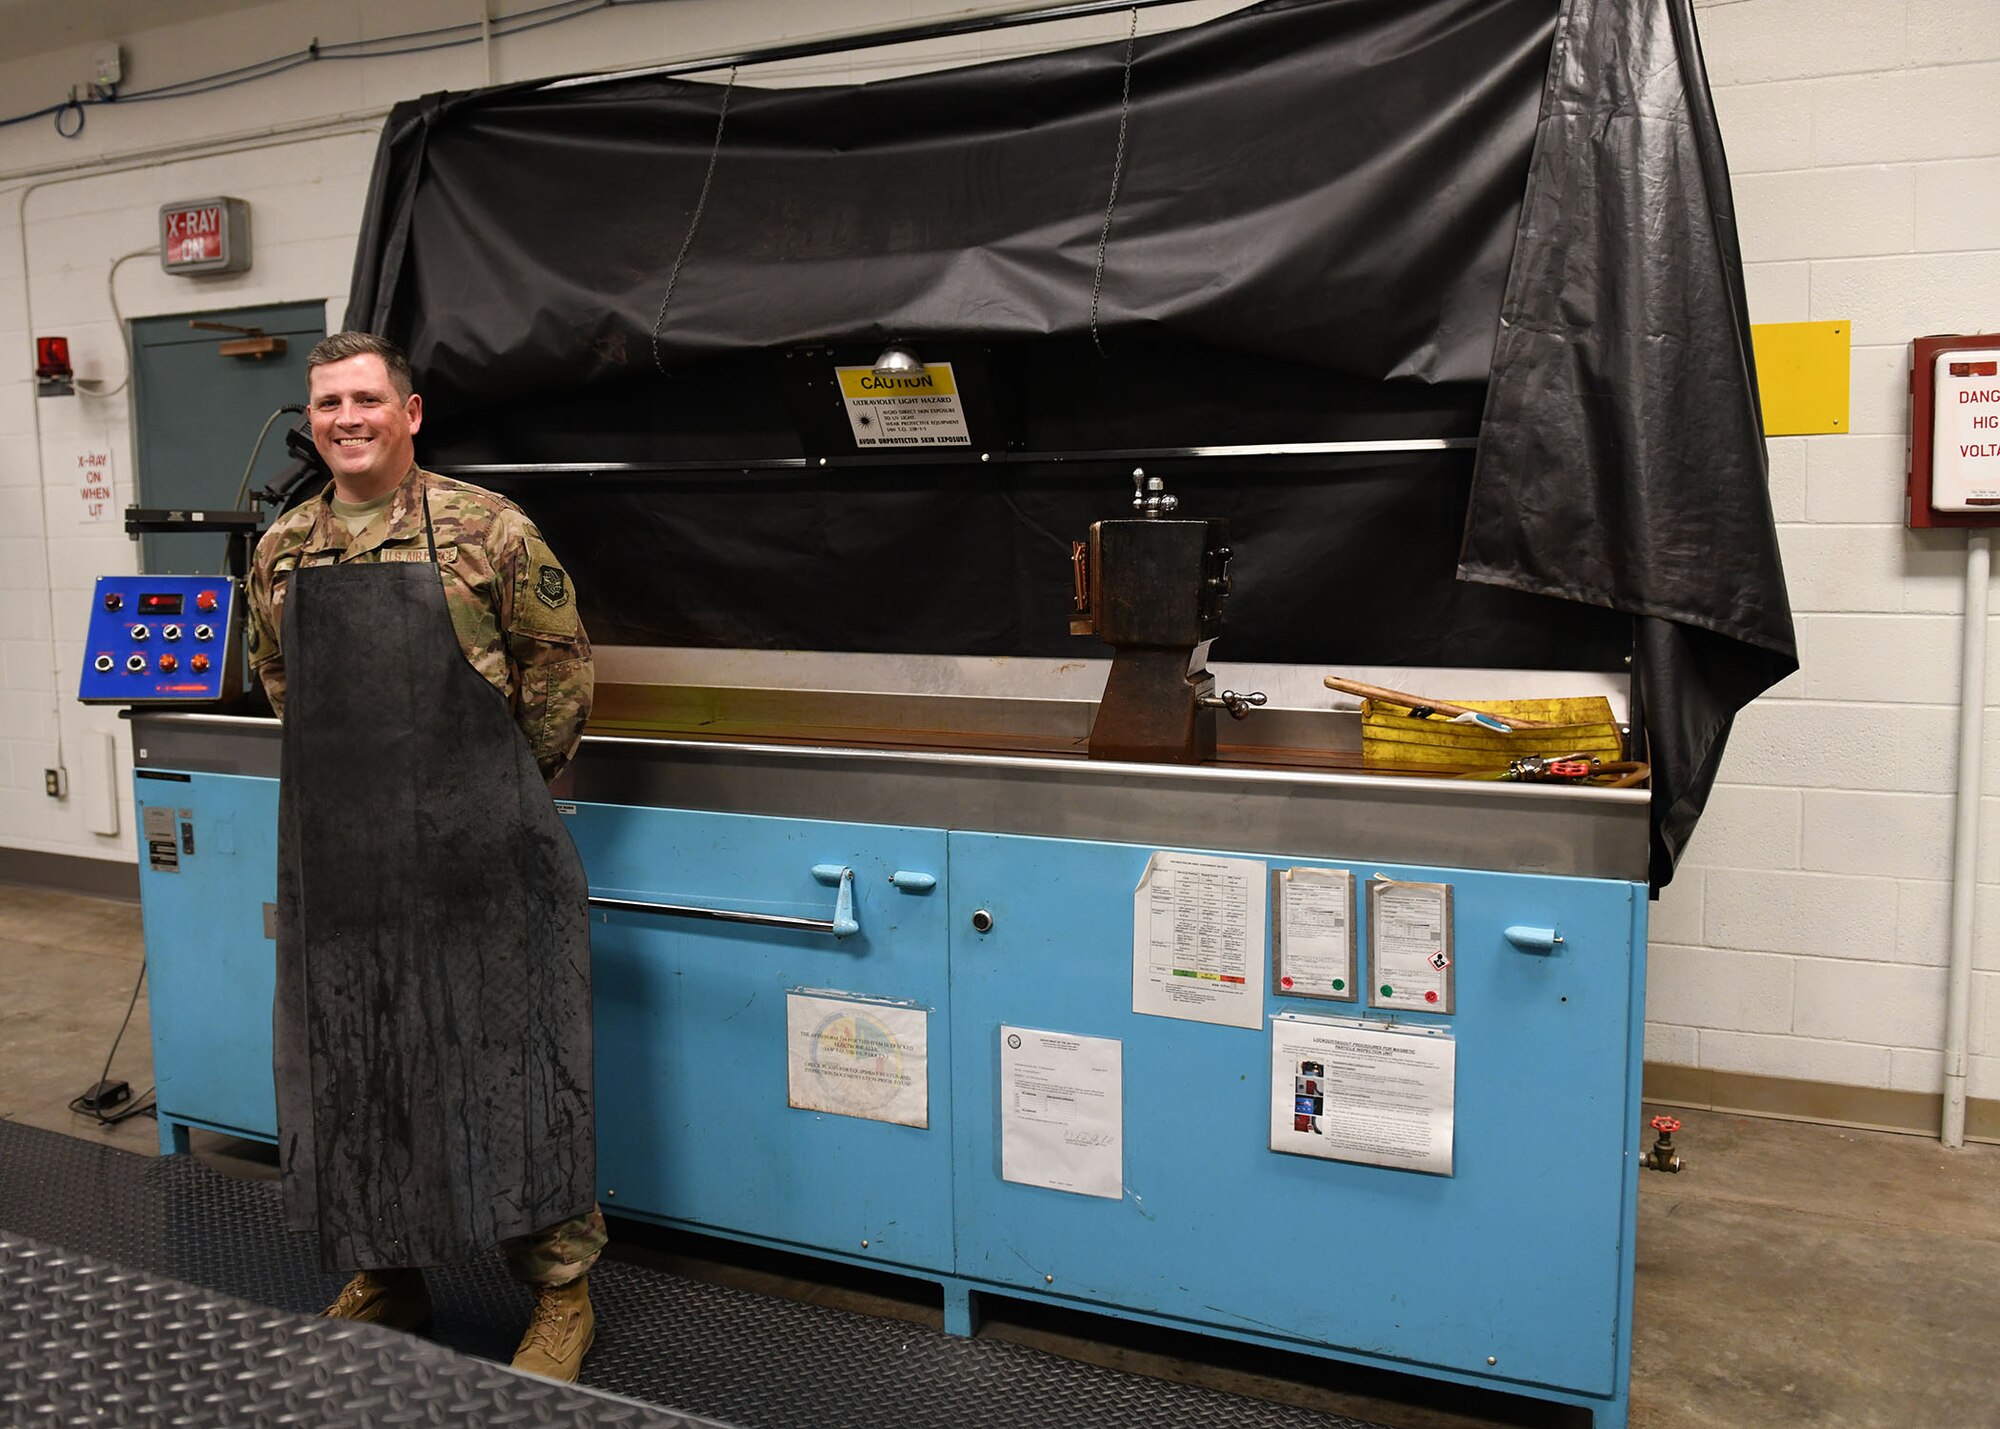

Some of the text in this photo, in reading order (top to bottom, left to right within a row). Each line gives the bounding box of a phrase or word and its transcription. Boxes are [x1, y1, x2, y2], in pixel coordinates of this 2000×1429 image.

[168, 208, 217, 238] X-RAY
[182, 237, 205, 261] ON
[853, 399, 896, 407] ULTRAVIOLET
[921, 396, 952, 404] HAZARD
[936, 435, 969, 443] EXPOSURE
[77, 454, 107, 468] X-RAY
[80, 487, 111, 500] WHEN
[406, 551, 423, 561] AIR
[424, 549, 454, 561] FRCE
